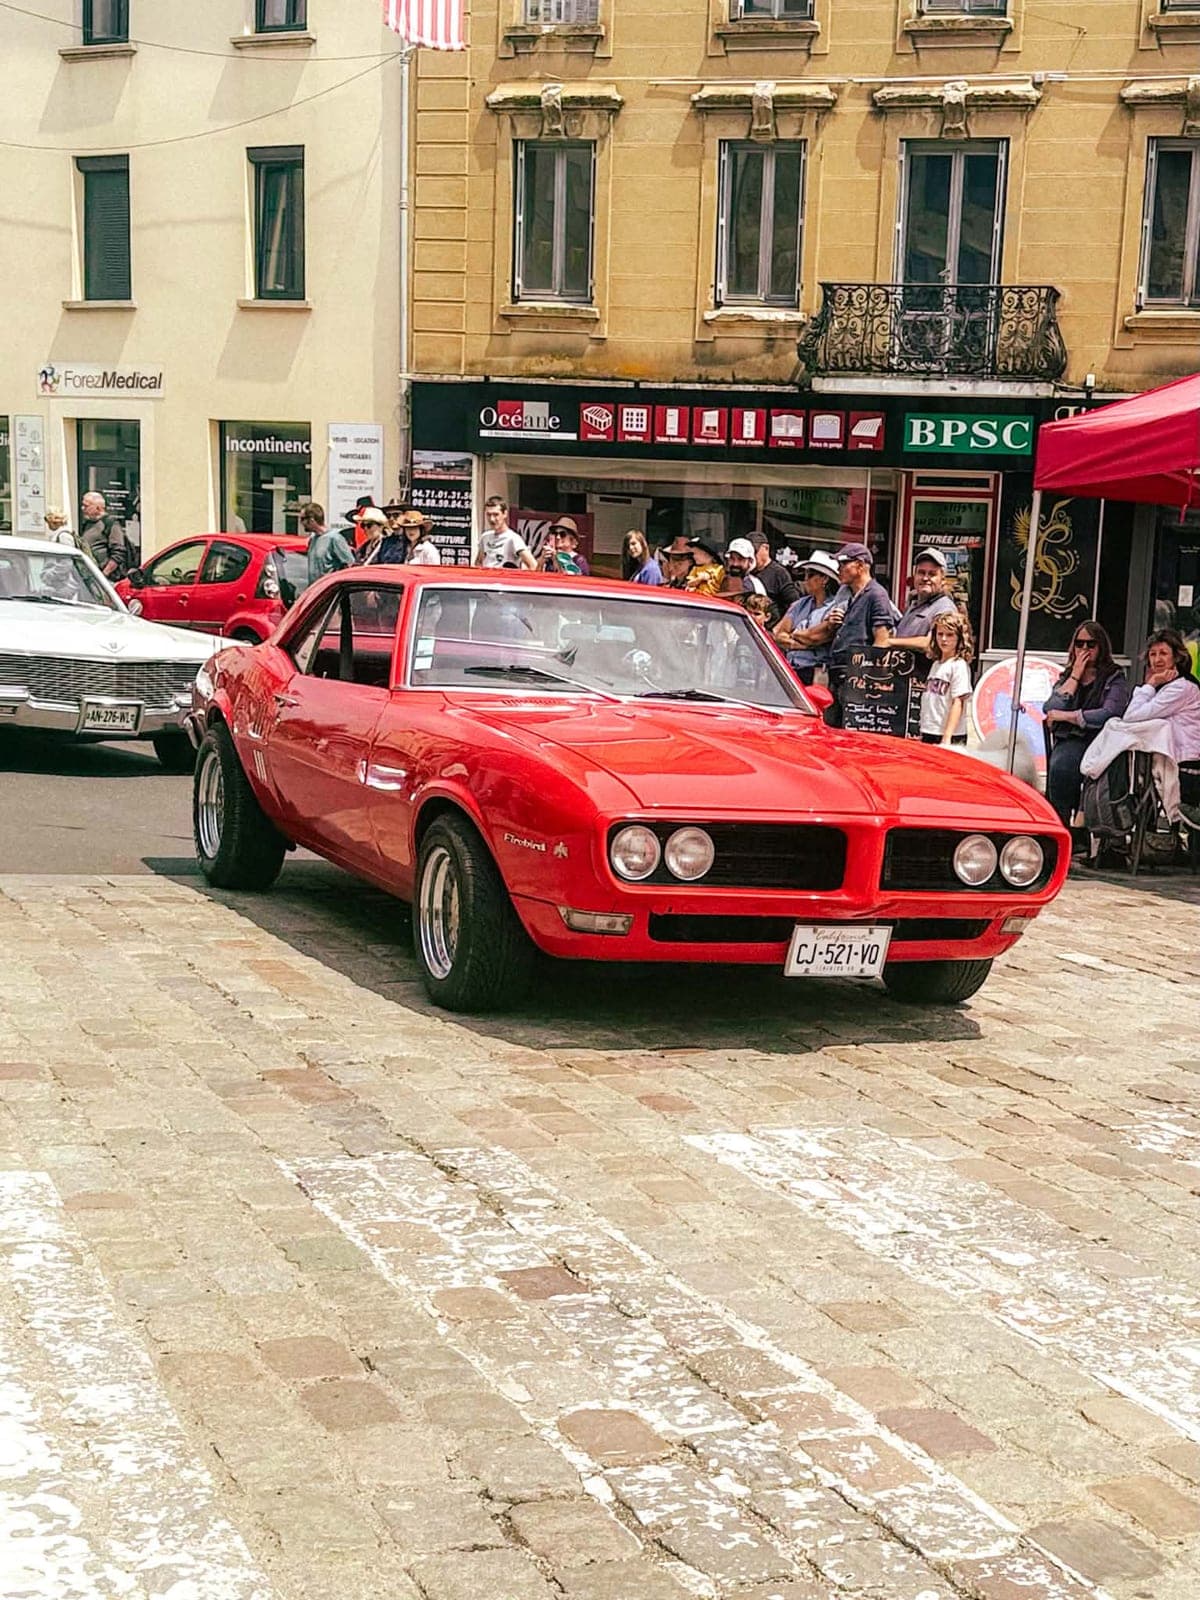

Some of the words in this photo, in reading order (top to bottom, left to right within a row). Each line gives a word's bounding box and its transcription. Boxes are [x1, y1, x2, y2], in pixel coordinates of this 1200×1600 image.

[64, 371, 162, 389] ForezMedical
[480, 407, 561, 430] Océane
[908, 419, 1030, 449] BPSC
[226, 436, 311, 454] Incontinenc
[431, 535, 467, 544] VERTURE
[919, 533, 953, 544] ENTRÉE
[503, 832, 546, 852] Firebird
